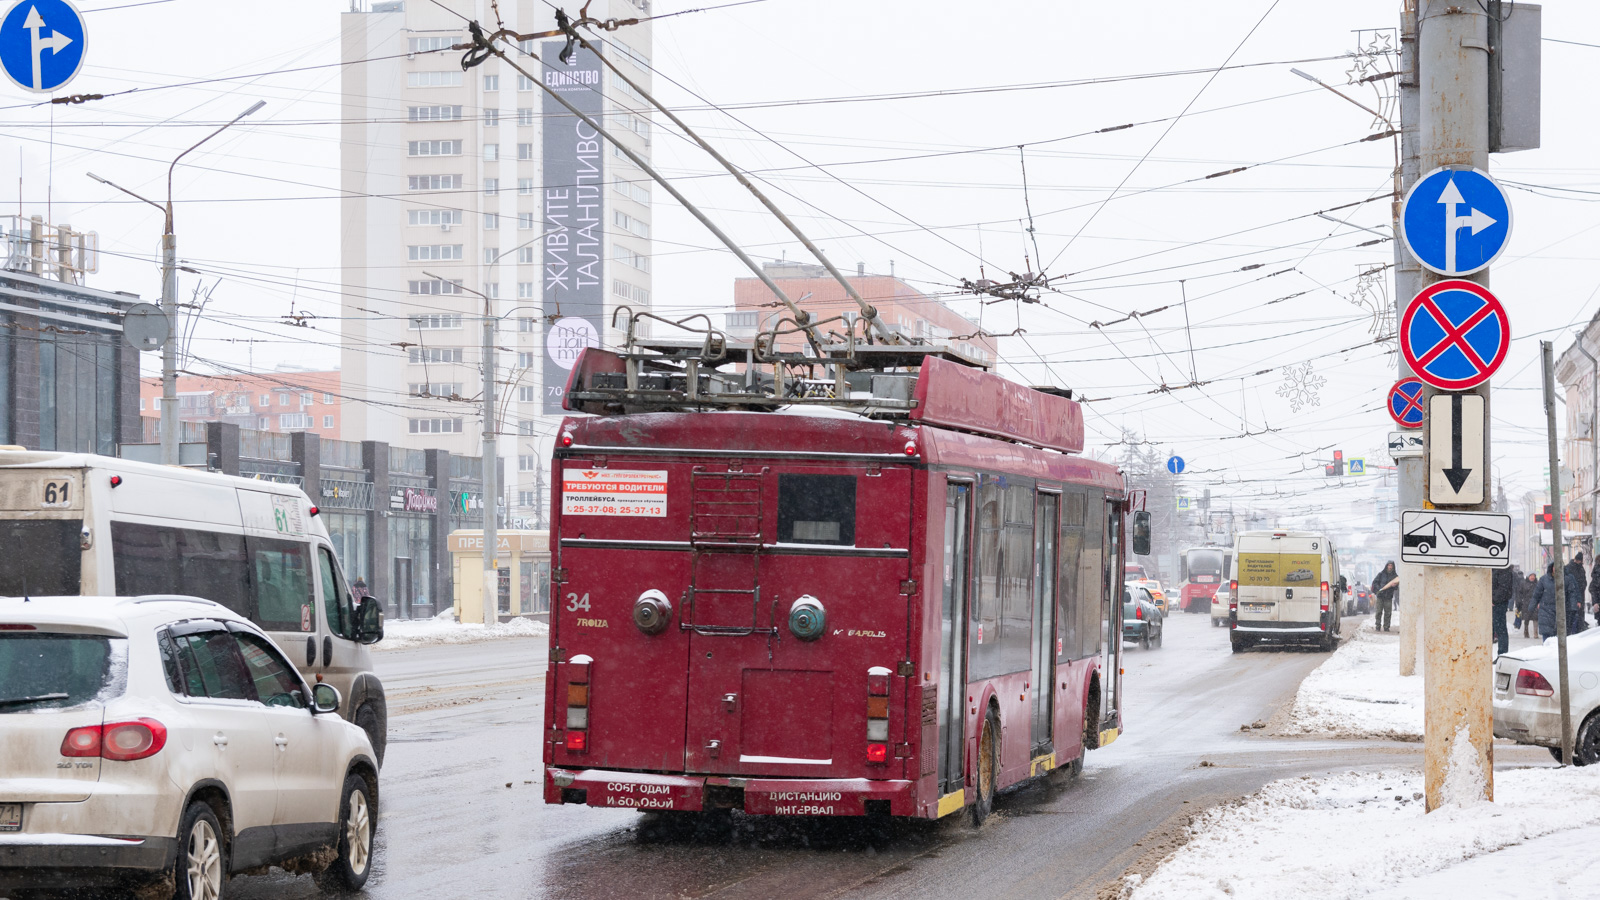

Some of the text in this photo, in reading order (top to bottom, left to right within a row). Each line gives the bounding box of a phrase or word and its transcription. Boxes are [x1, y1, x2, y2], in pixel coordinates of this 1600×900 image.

[546, 70, 598, 87] ЕДИНСТВО
[576, 117, 600, 290] ТАЛАНТЛИВО
[546, 189, 568, 290] ЖИВИТЕ
[45, 482, 68, 504] 61
[574, 506, 617, 514] 25-37-08;
[274, 508, 289, 532] 61
[566, 592, 591, 612] 34
[607, 796, 614, 805] И
[769, 792, 842, 802] ДИСТАНЦИЮ
[775, 806, 834, 814] ИНТЕРВАЛ
